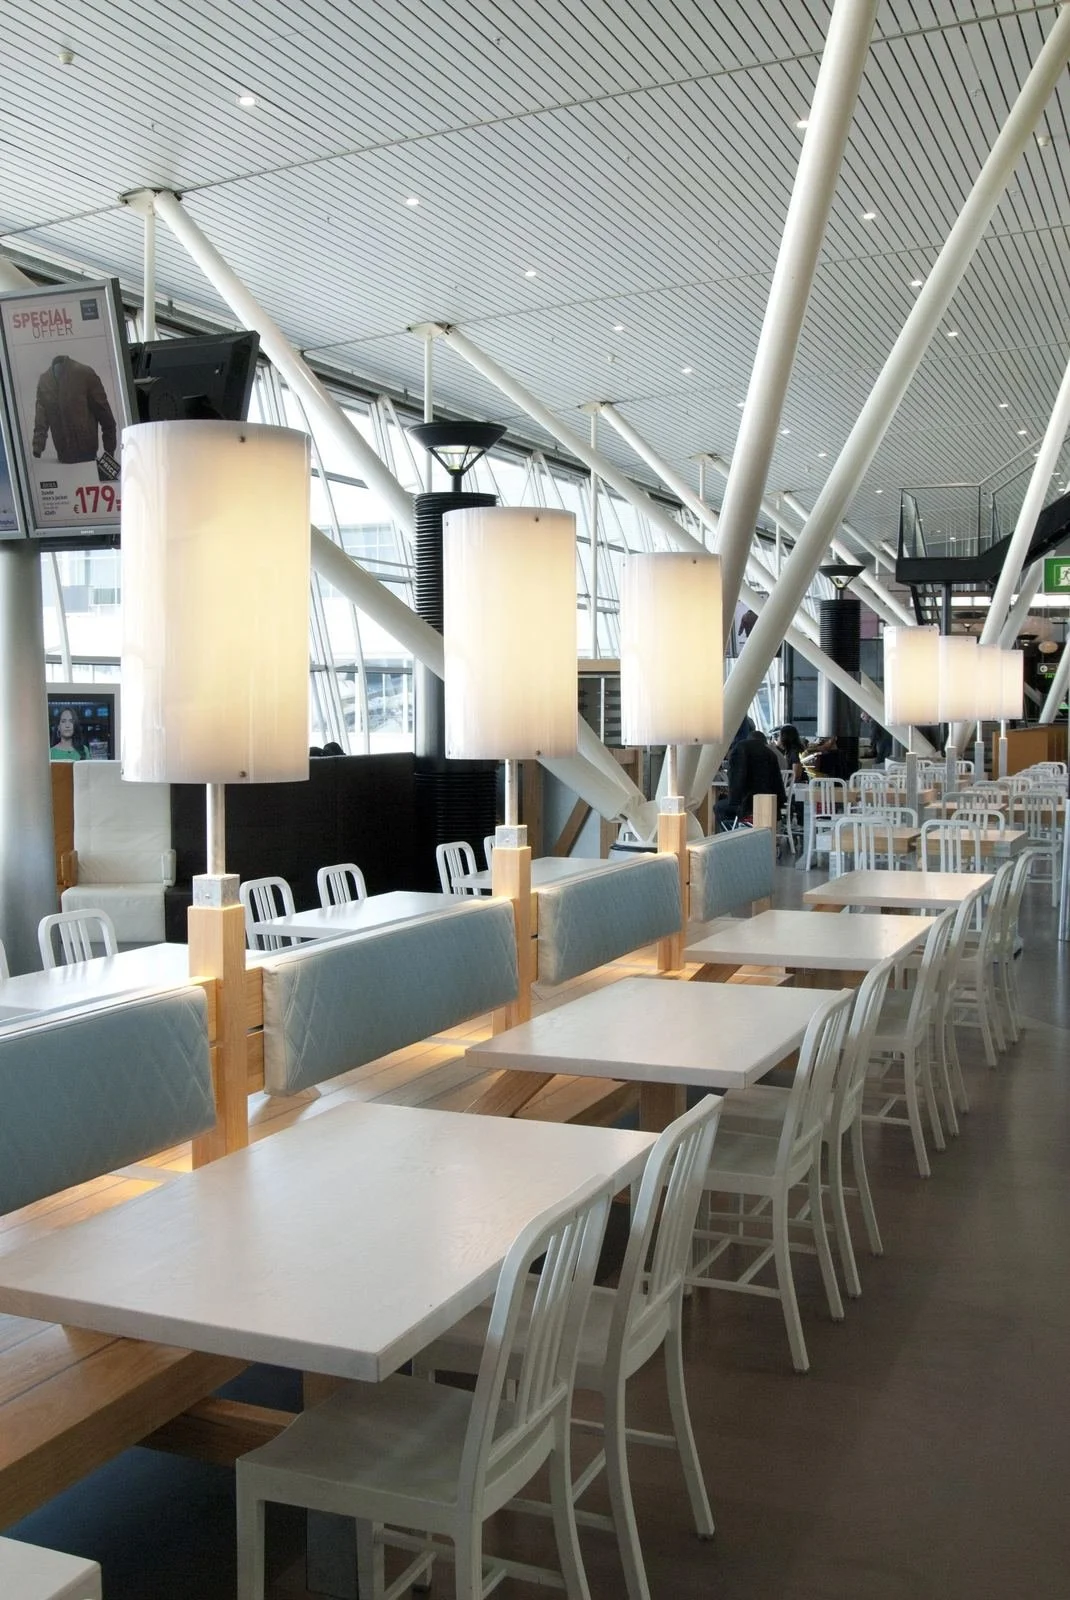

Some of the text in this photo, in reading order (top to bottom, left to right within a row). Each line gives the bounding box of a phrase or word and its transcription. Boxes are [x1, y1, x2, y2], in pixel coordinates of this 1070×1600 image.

[12, 308, 72, 328] SPECIAL
[32, 322, 74, 339] OFFER
[100, 459, 117, 477] PRICE
